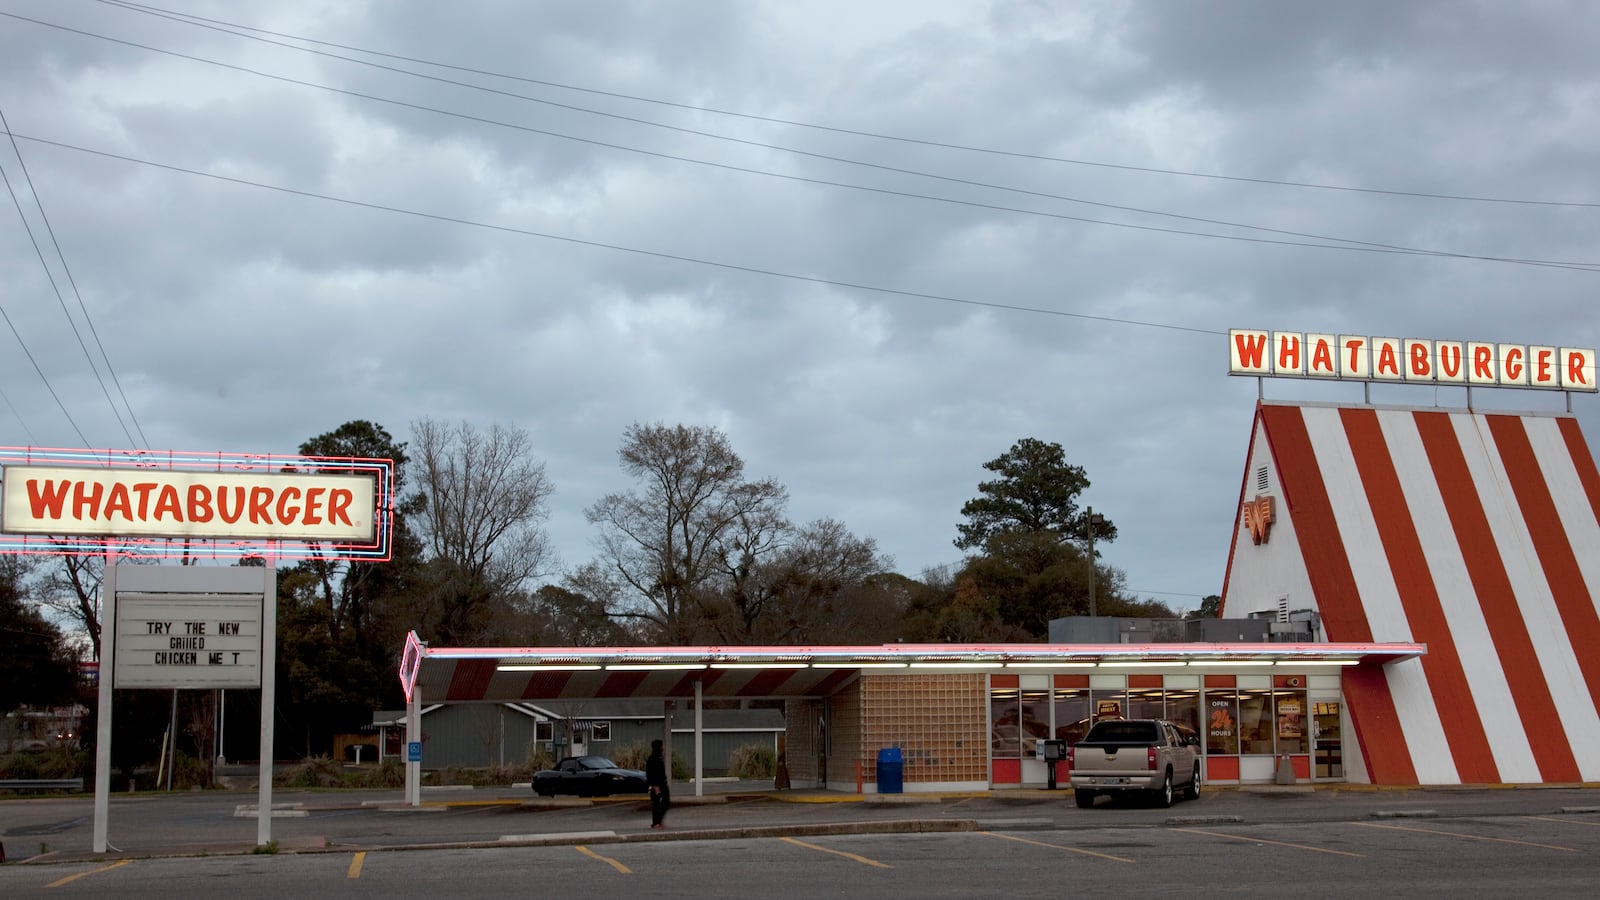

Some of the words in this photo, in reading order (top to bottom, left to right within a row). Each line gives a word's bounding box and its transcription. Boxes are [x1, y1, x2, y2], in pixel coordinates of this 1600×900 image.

[1235, 333, 1587, 385] WHATABURGER
[26, 479, 354, 527] WHATABURGER
[146, 622, 172, 635] TRY
[184, 622, 206, 635] THE
[218, 622, 240, 635] NEW
[155, 652, 197, 665] CHICKEN
[1211, 708, 1233, 729] 24
